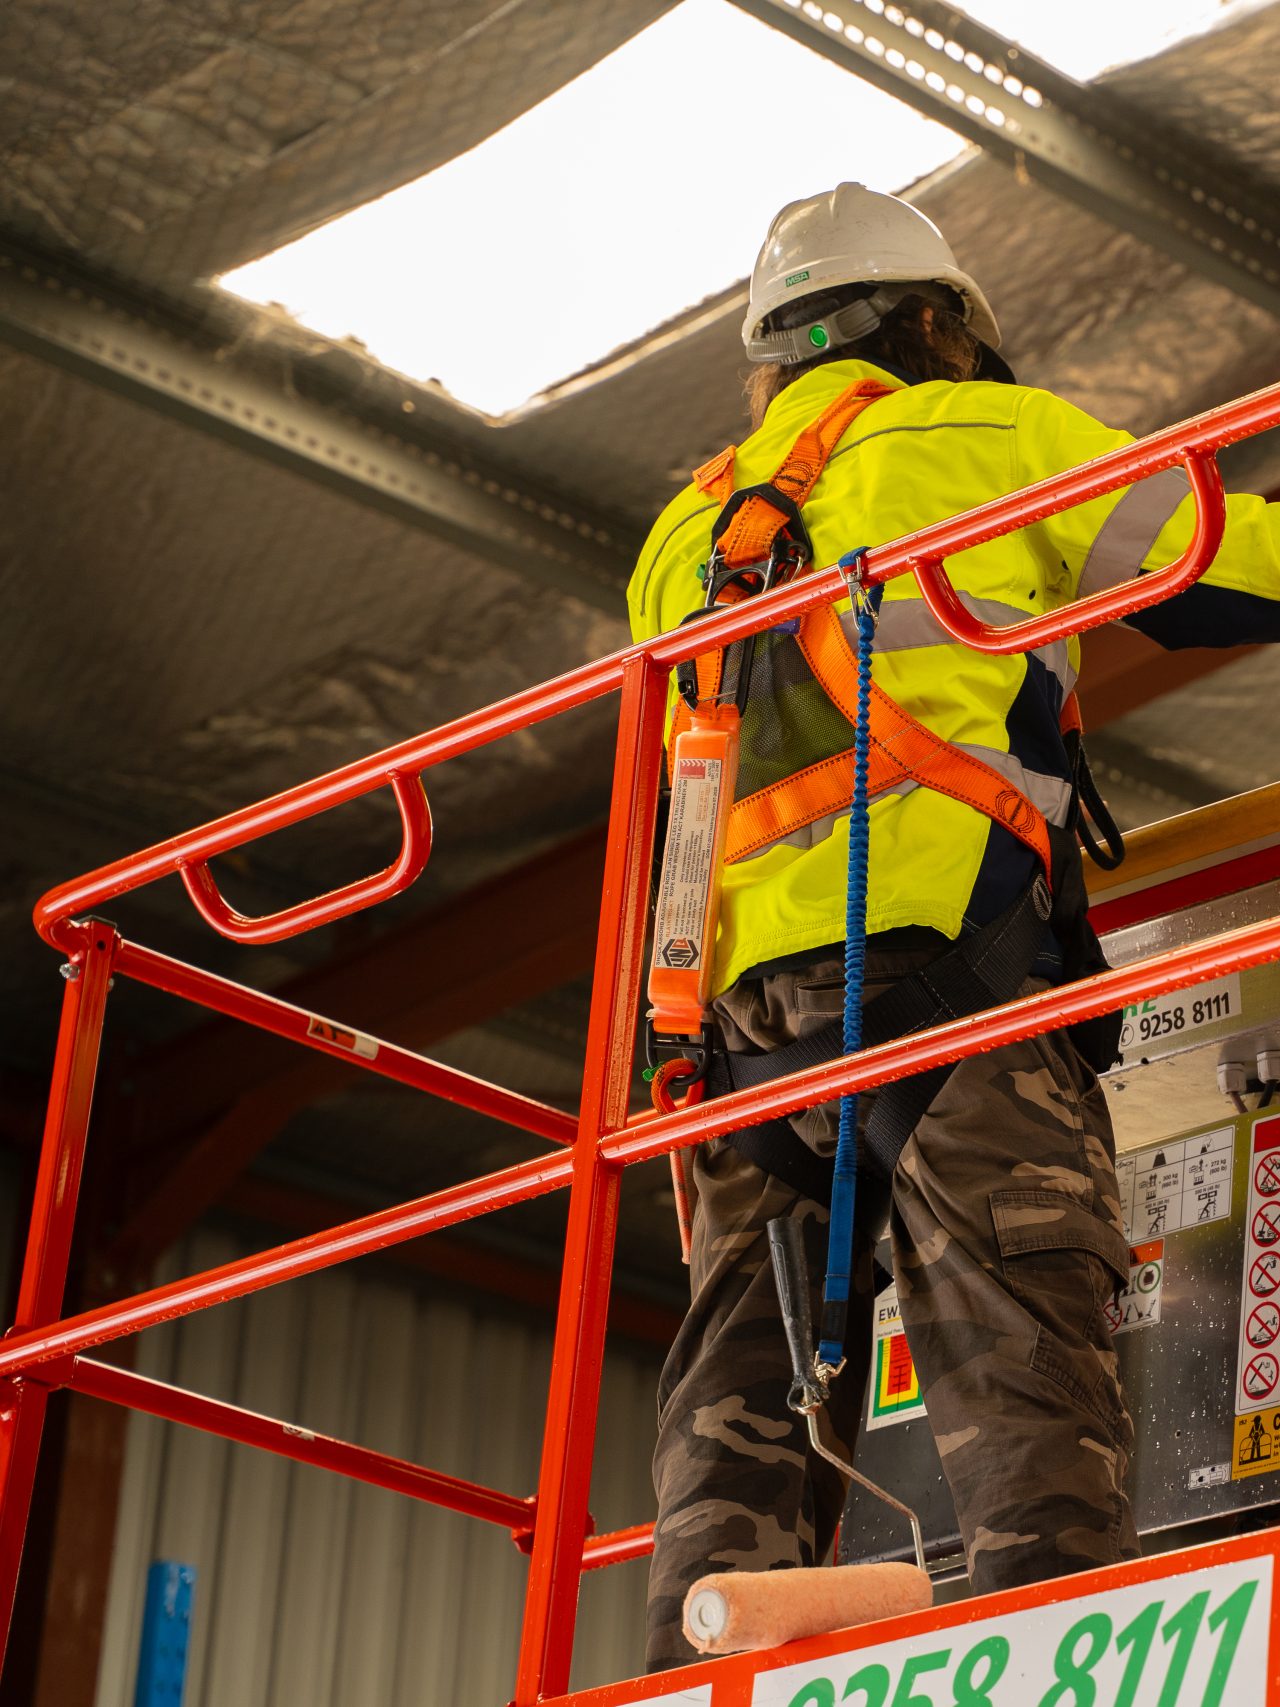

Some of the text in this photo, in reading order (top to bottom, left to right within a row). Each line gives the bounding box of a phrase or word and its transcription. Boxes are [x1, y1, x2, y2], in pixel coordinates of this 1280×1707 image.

[786, 272, 808, 287] MSA
[1140, 1007, 1185, 1041] 9258
[1192, 992, 1230, 1024] 8111
